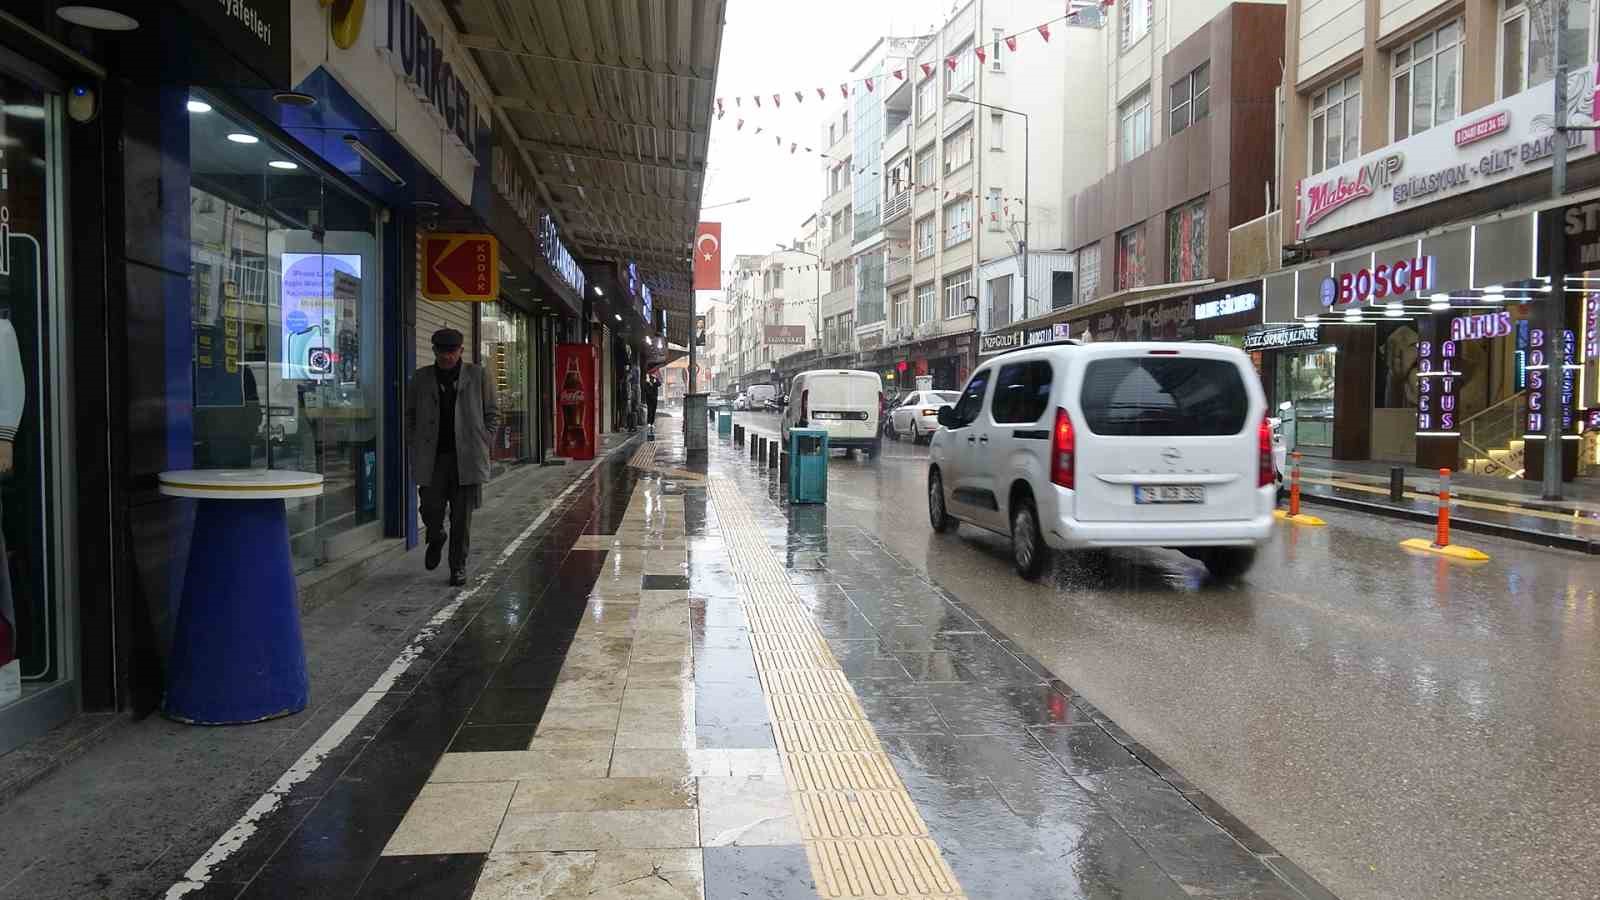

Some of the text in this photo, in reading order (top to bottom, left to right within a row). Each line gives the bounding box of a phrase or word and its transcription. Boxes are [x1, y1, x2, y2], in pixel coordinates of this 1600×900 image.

[218, 0, 271, 46] yafetleri
[1306, 166, 1373, 222] Mabel
[477, 244, 487, 291] KODAK
[1338, 256, 1432, 304] BOSCH
[1451, 312, 1512, 340] ALTUS
[1419, 341, 1431, 428] BOSCH
[1441, 340, 1455, 429] ALTUS
[1528, 329, 1544, 431] BOSCH
